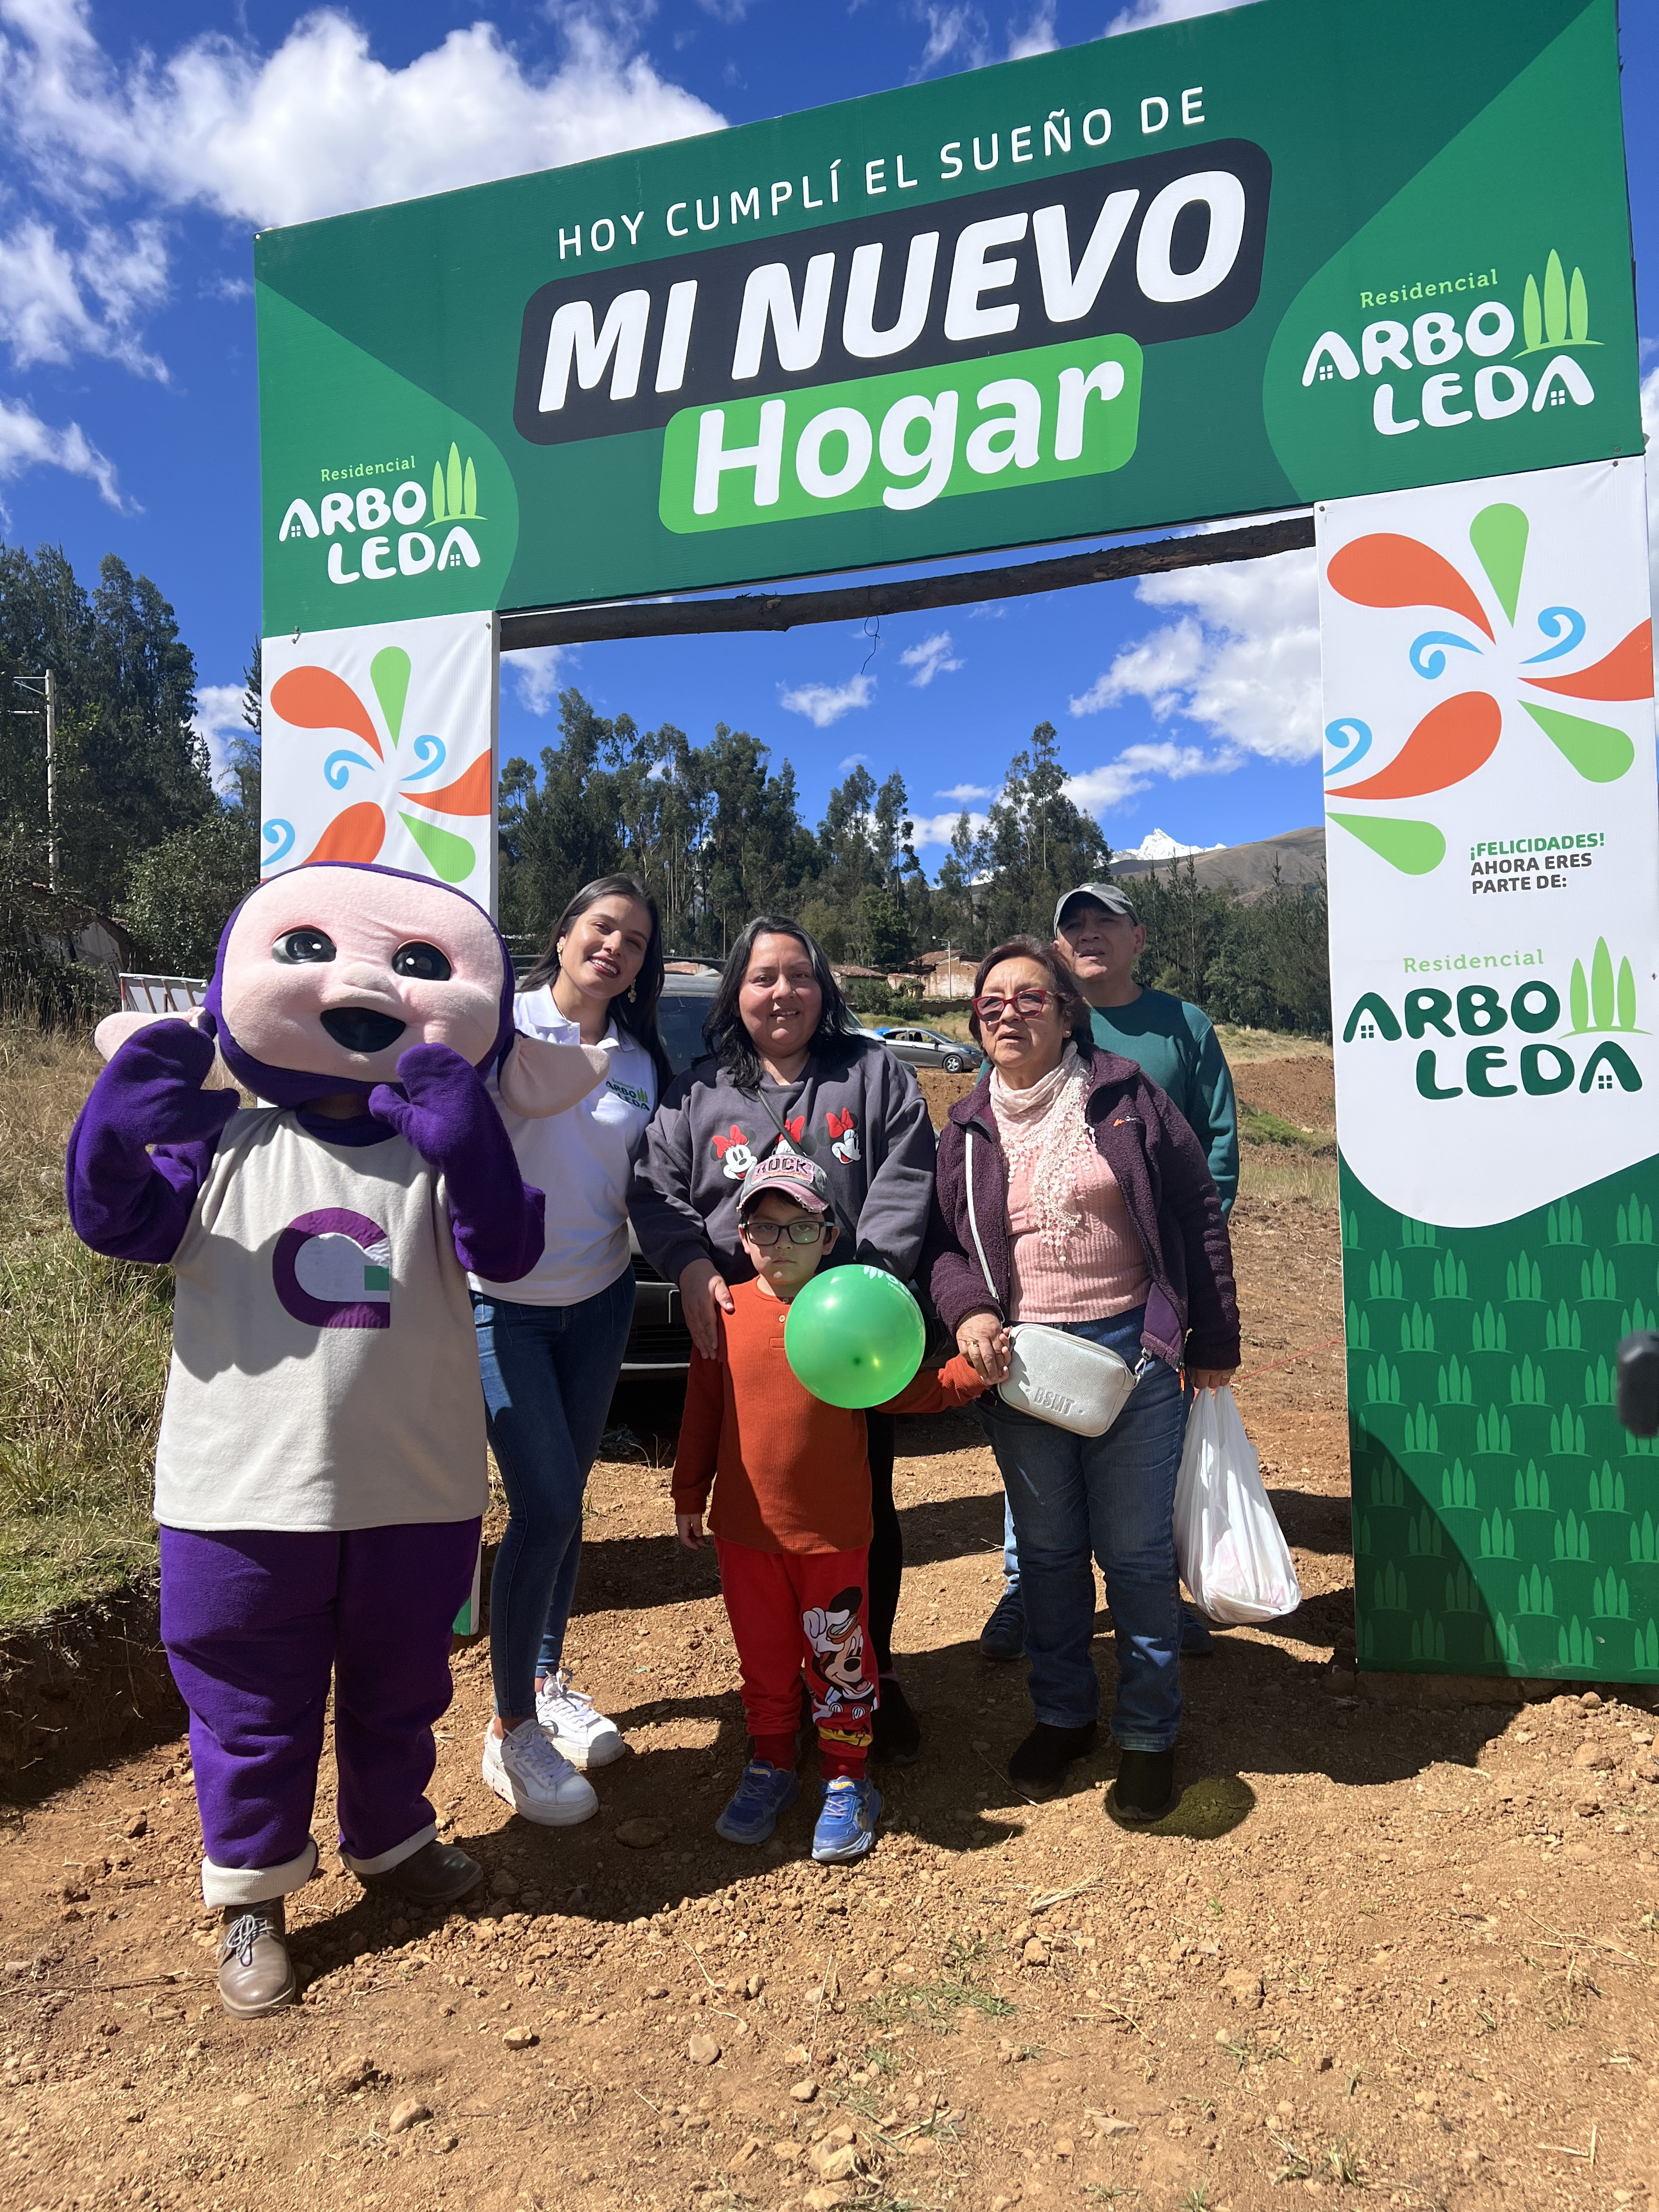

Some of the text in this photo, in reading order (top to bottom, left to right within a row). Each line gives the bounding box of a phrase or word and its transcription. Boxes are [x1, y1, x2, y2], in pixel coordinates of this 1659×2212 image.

[558, 86, 1205, 259] HOY CUMPLÍ EL SUEÑO DE
[538, 170, 1246, 413] MI NUEVO
[1359, 268, 1498, 308] Residencial
[1301, 301, 1515, 387] ARBO
[1373, 354, 1595, 436] LEDA
[692, 360, 1125, 511] Hogar
[320, 455, 416, 482] Residencial
[278, 481, 427, 541] ARBO
[327, 526, 481, 584] LEDA
[1470, 832, 1605, 861] ¡FELICIDADES!
[1471, 853, 1592, 876] AHORA ERES
[1472, 874, 1567, 894] PARTE DE:
[1403, 949, 1544, 973] Residencial
[1342, 980, 1561, 1043] ARBO
[606, 1081, 636, 1099] ARBO
[1415, 1041, 1643, 1101] LEDA
